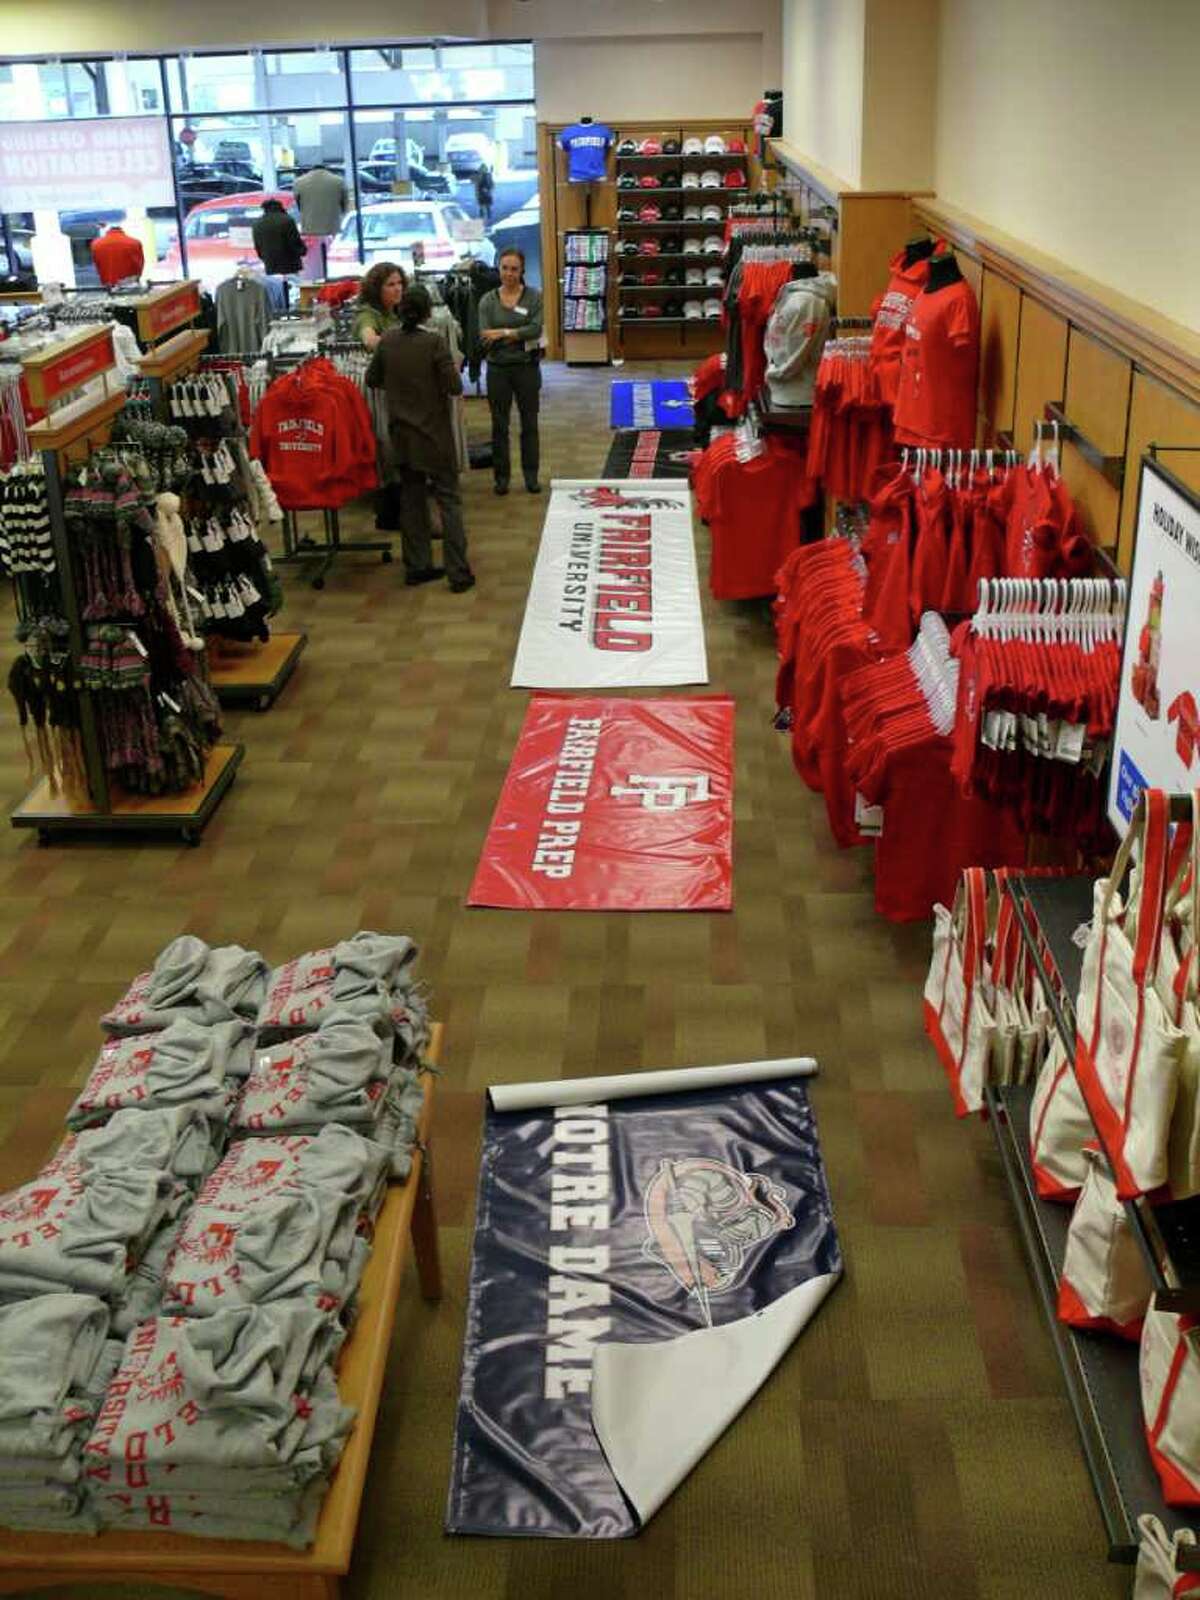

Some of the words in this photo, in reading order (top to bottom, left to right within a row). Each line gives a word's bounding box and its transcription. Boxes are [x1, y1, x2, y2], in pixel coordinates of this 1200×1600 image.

[1153, 502, 1185, 545] HOLIDAY
[559, 522, 594, 633] UNIVERSITY
[593, 514, 653, 653] FAIRFIELD
[547, 717, 602, 815] FAIRFIELD
[532, 820, 584, 881] PREP
[545, 1244, 612, 1401] DAME
